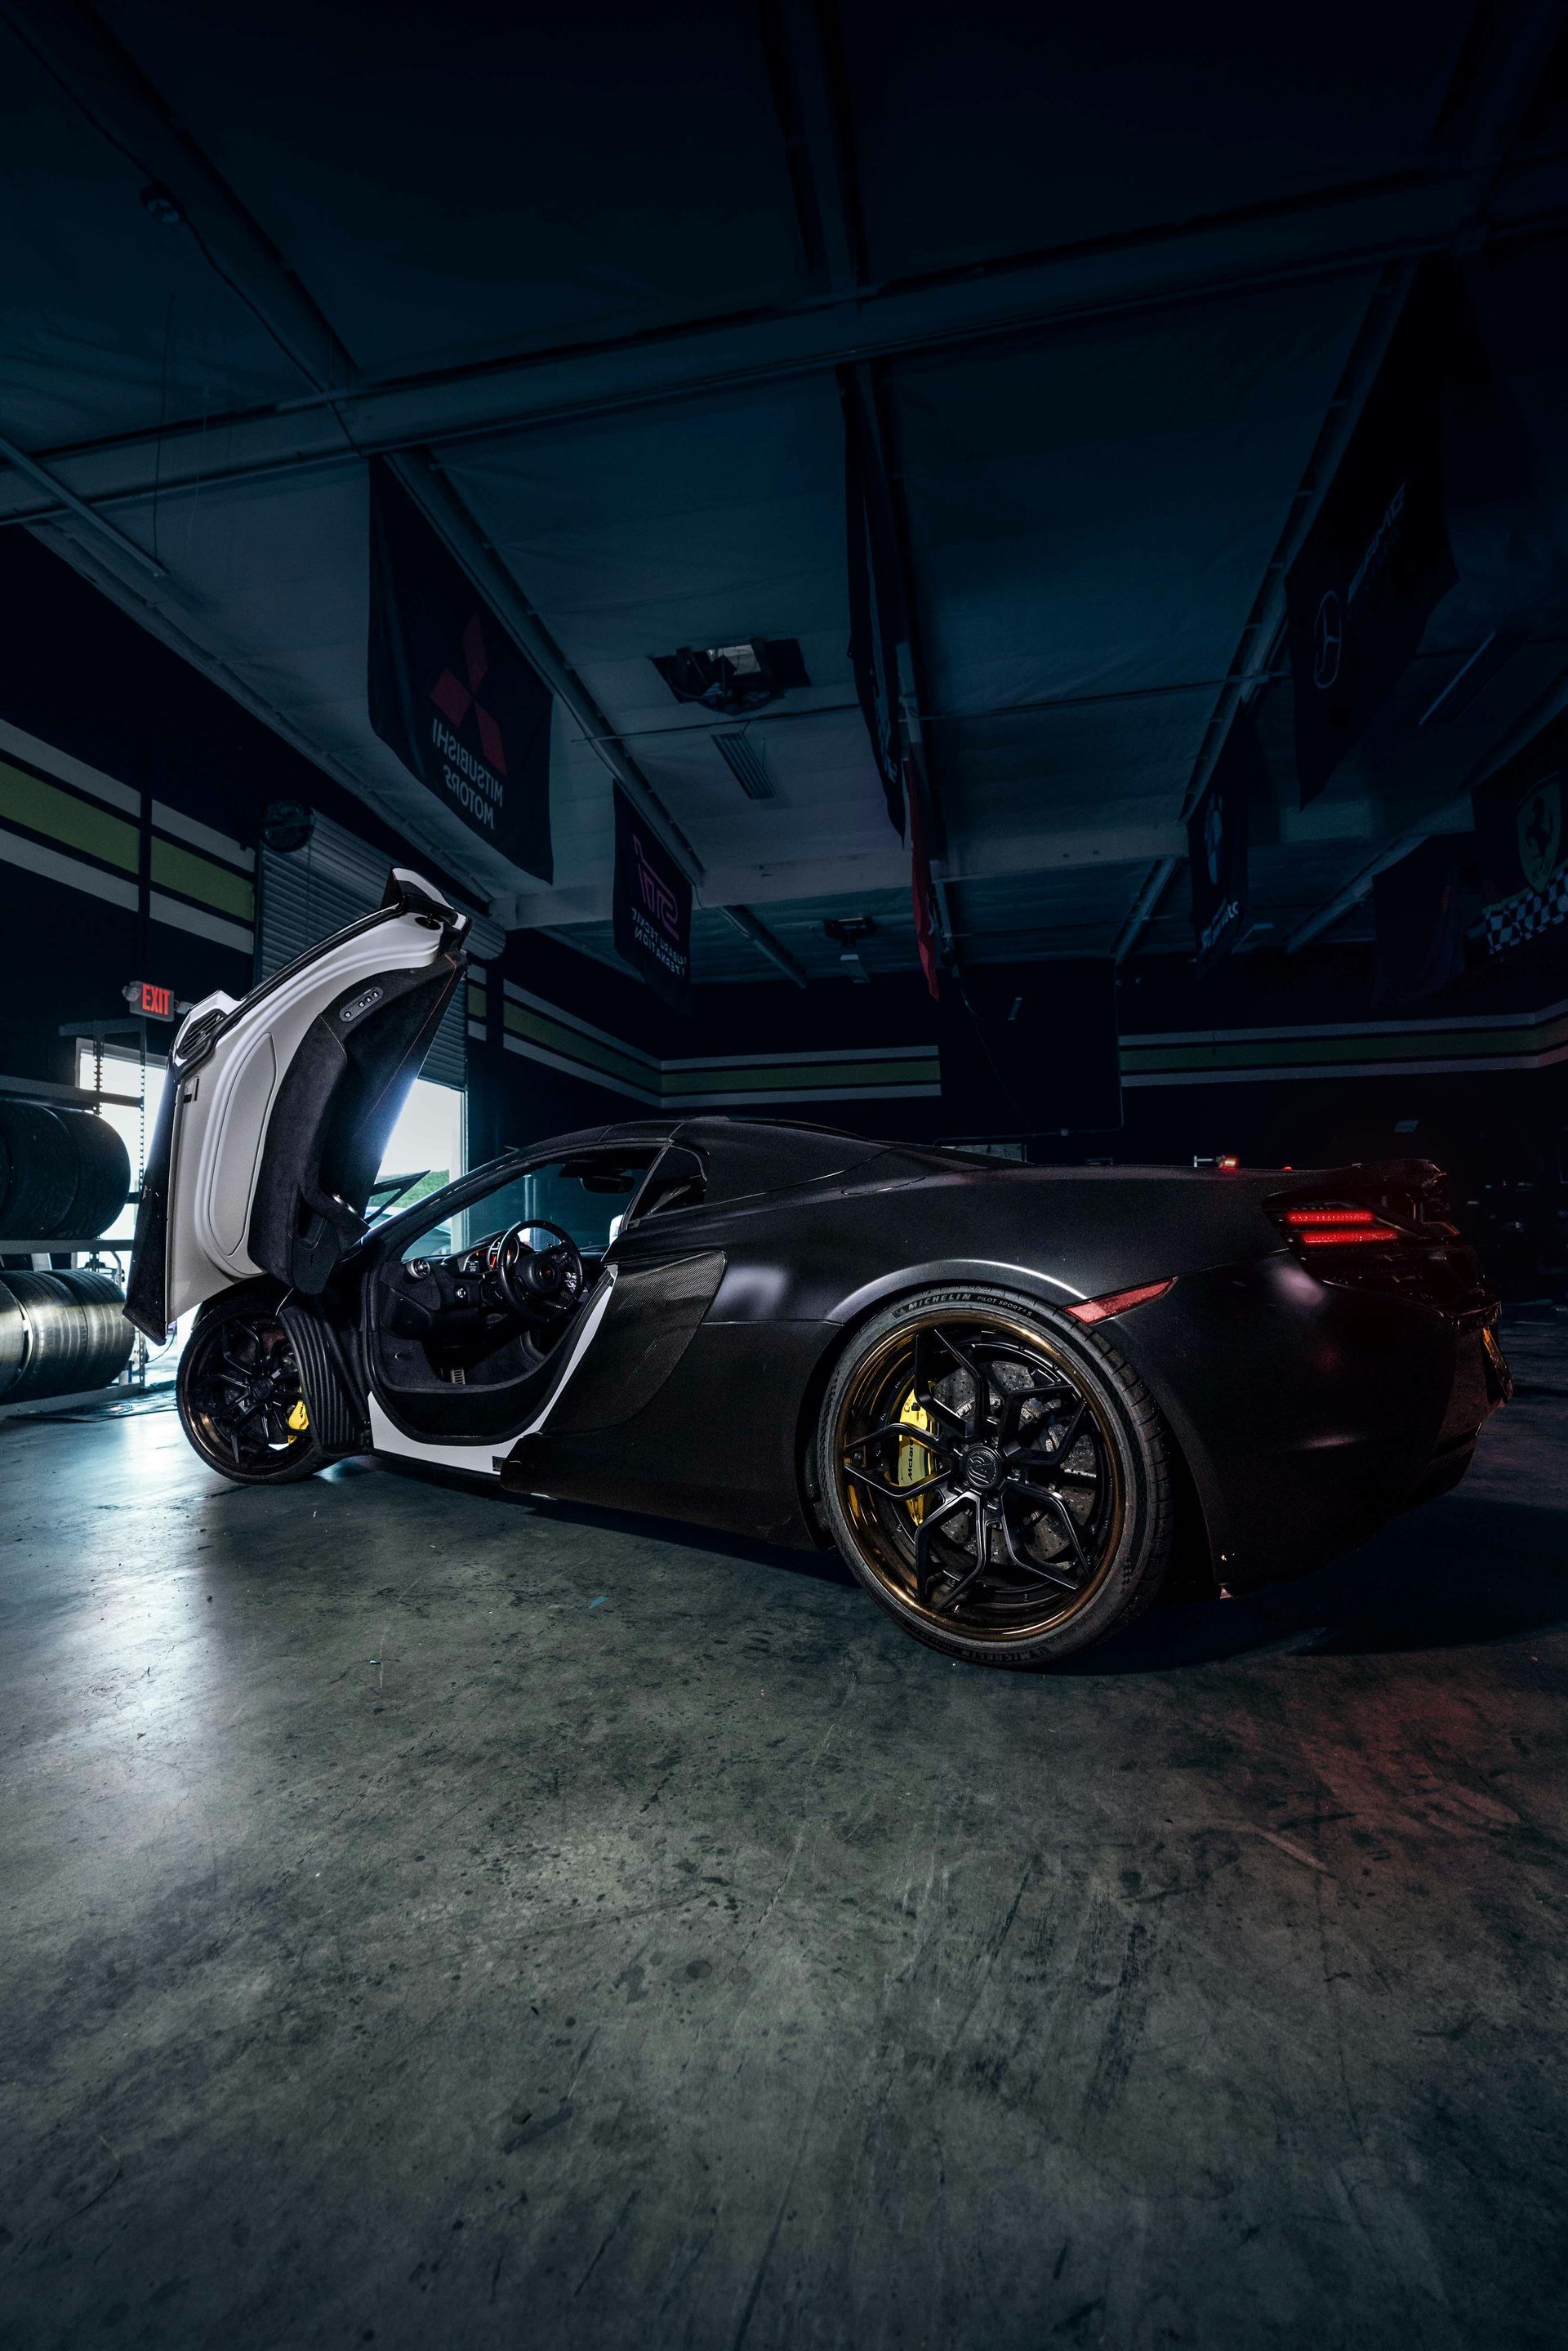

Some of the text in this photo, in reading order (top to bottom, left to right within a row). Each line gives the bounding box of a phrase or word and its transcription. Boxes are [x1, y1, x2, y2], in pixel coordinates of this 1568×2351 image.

[142, 984, 170, 1015] EXIT
[908, 1293, 971, 1310] MICHELIN
[977, 1296, 997, 1304] PILOT
[999, 1300, 1022, 1312] SPORT
